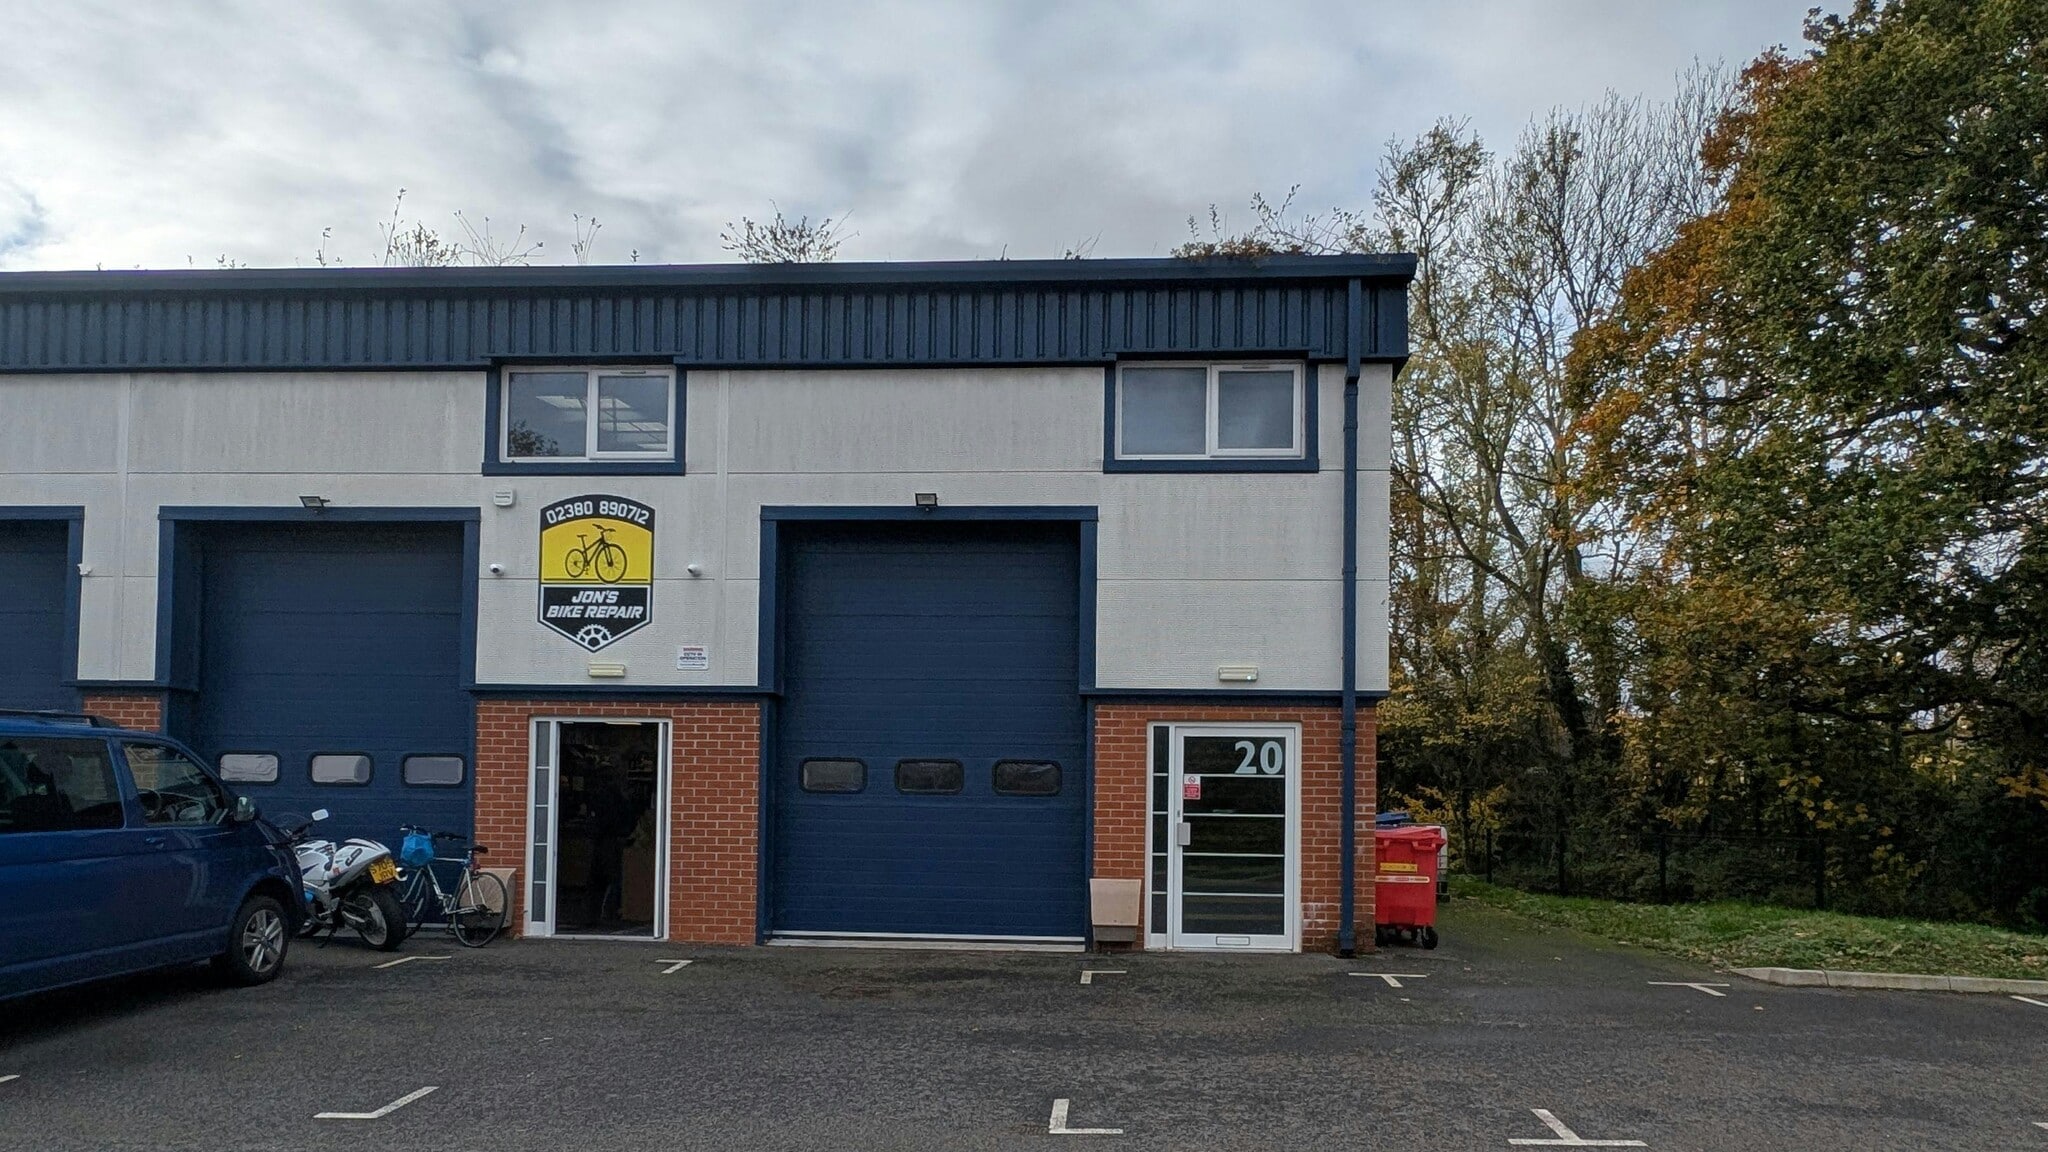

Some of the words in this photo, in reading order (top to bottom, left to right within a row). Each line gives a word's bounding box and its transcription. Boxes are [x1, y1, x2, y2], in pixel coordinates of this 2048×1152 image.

[545, 501, 593, 524] 02380
[599, 501, 650, 525] 890712
[571, 590, 620, 604] JON'S
[546, 605, 583, 618] BIKE
[584, 605, 644, 619] REPAIR
[1234, 740, 1283, 775] 20
